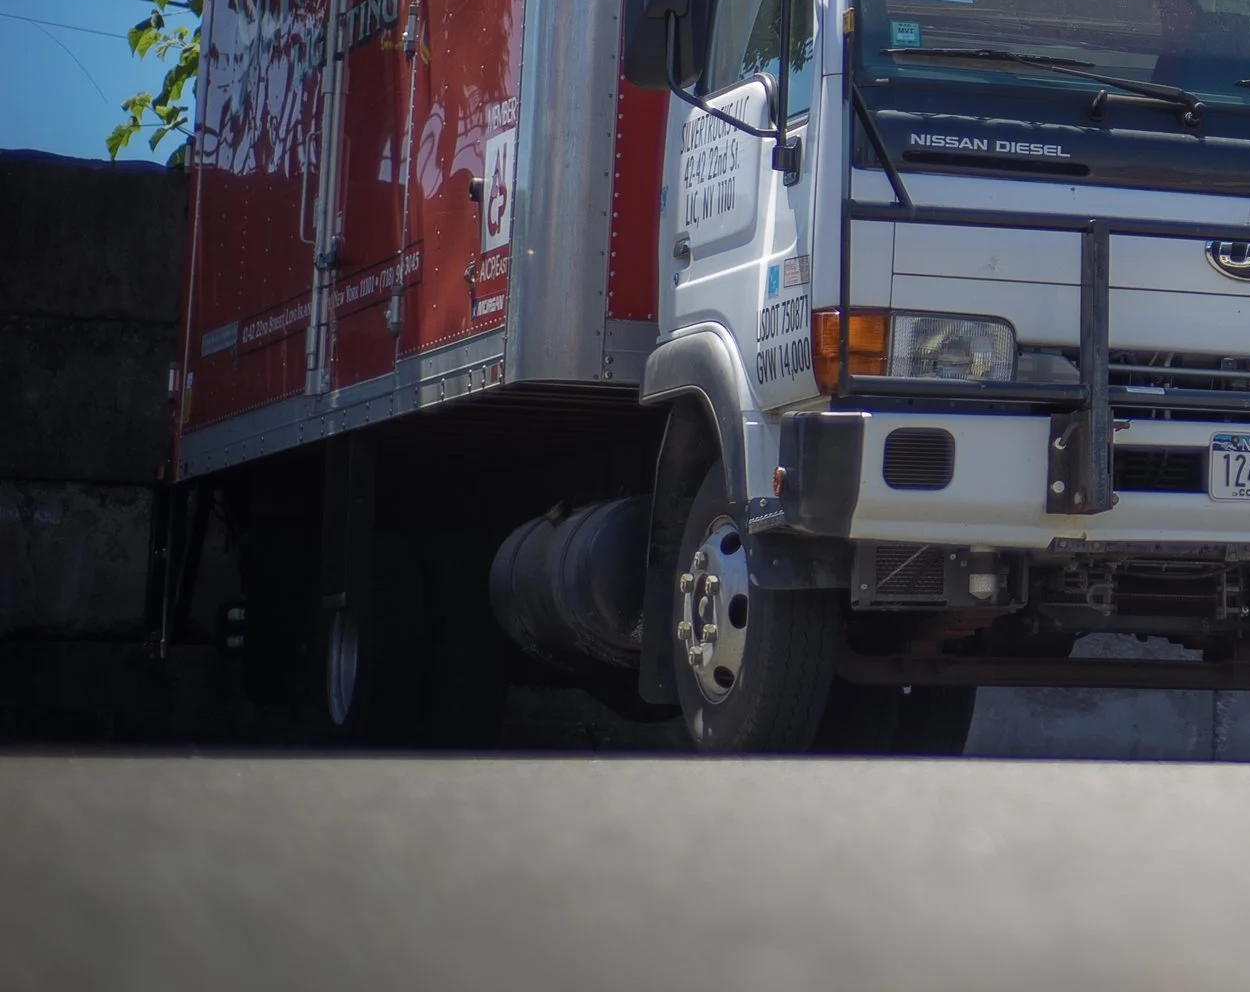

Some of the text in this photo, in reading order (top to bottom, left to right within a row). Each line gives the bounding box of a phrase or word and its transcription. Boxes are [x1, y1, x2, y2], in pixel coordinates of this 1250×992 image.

[487, 96, 517, 131] MEMBER
[684, 138, 740, 189] 42-42 22nd St.
[910, 133, 1071, 158] NISSAN DIESEL
[685, 176, 736, 229] LIC, NY 11101
[756, 294, 808, 343] USDOT 750871
[756, 336, 811, 385] GVW 14,000
